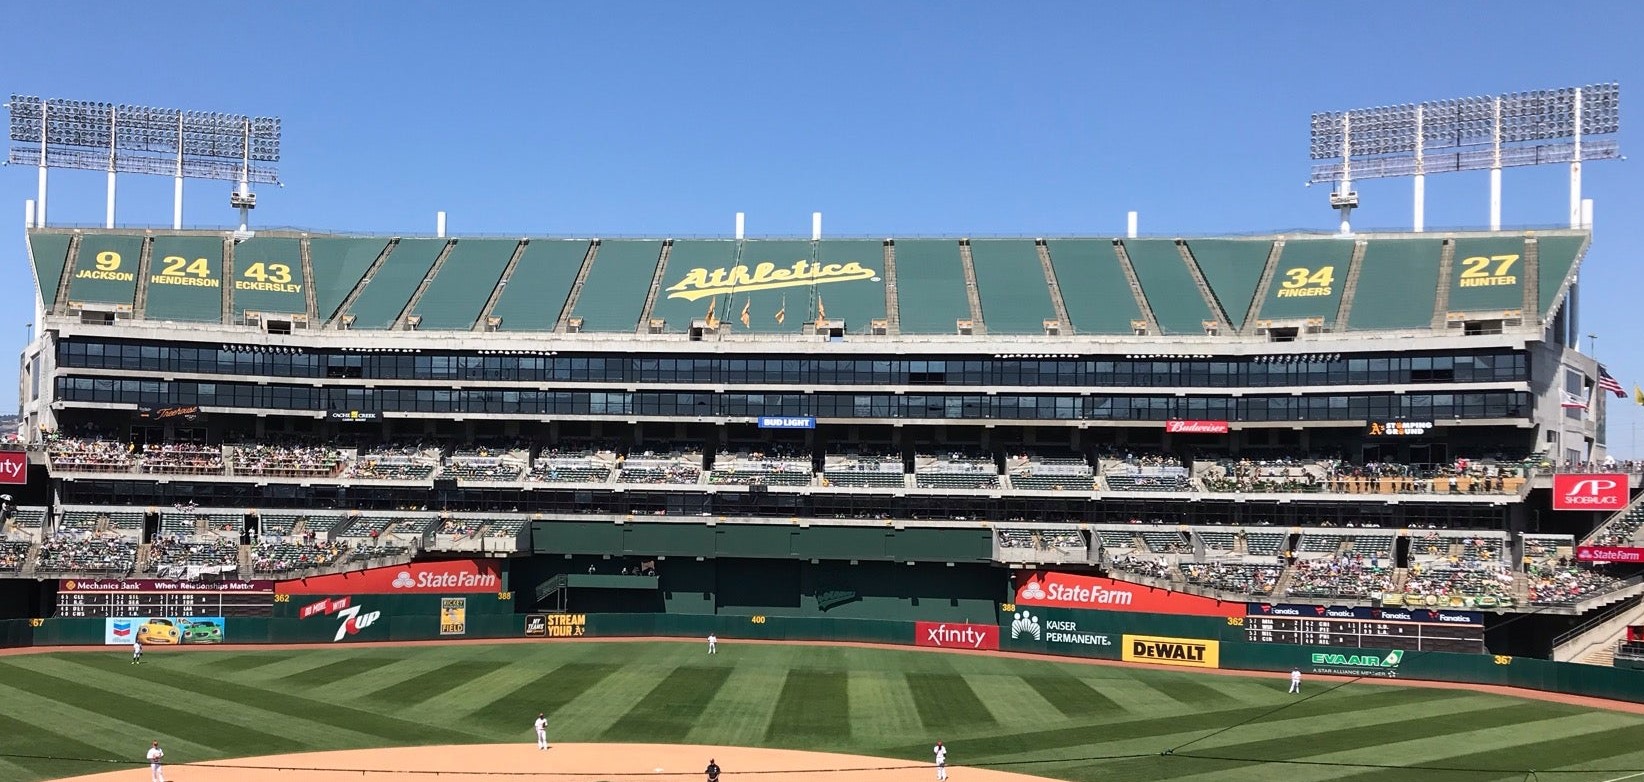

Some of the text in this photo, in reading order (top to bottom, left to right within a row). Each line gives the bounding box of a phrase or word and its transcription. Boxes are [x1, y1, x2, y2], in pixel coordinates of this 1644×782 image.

[95, 251, 122, 271] 9
[162, 256, 210, 277] 24
[1460, 254, 1520, 278] 27
[76, 269, 134, 281] JACKSON
[244, 262, 291, 283] 43
[1282, 266, 1335, 289] 34
[151, 275, 219, 288] HENDERSON
[665, 259, 876, 300] Athletics
[1460, 276, 1516, 288] HUNTER
[235, 280, 301, 293] ECKERSLEY
[1277, 287, 1332, 298] FINGERS
[763, 418, 810, 427] BUD LIGHT
[1168, 421, 1226, 433] Budweiser
[77, 582, 119, 590] Mechanics
[180, 582, 228, 591] Relationships
[230, 582, 255, 590] Matter
[274, 594, 290, 602] 362
[498, 592, 511, 600] 388
[1002, 604, 1015, 612] 388
[547, 615, 586, 625] STREAM
[751, 615, 766, 624] 400
[1271, 607, 1470, 622] Fanatics Fanatics Fanatics Fanatics
[1046, 620, 1076, 631] KAISER
[1227, 617, 1243, 626] 362
[442, 624, 463, 632] FIELD
[547, 625, 572, 636] YOUR
[928, 625, 986, 648] xfinity
[1494, 655, 1512, 665] 367
